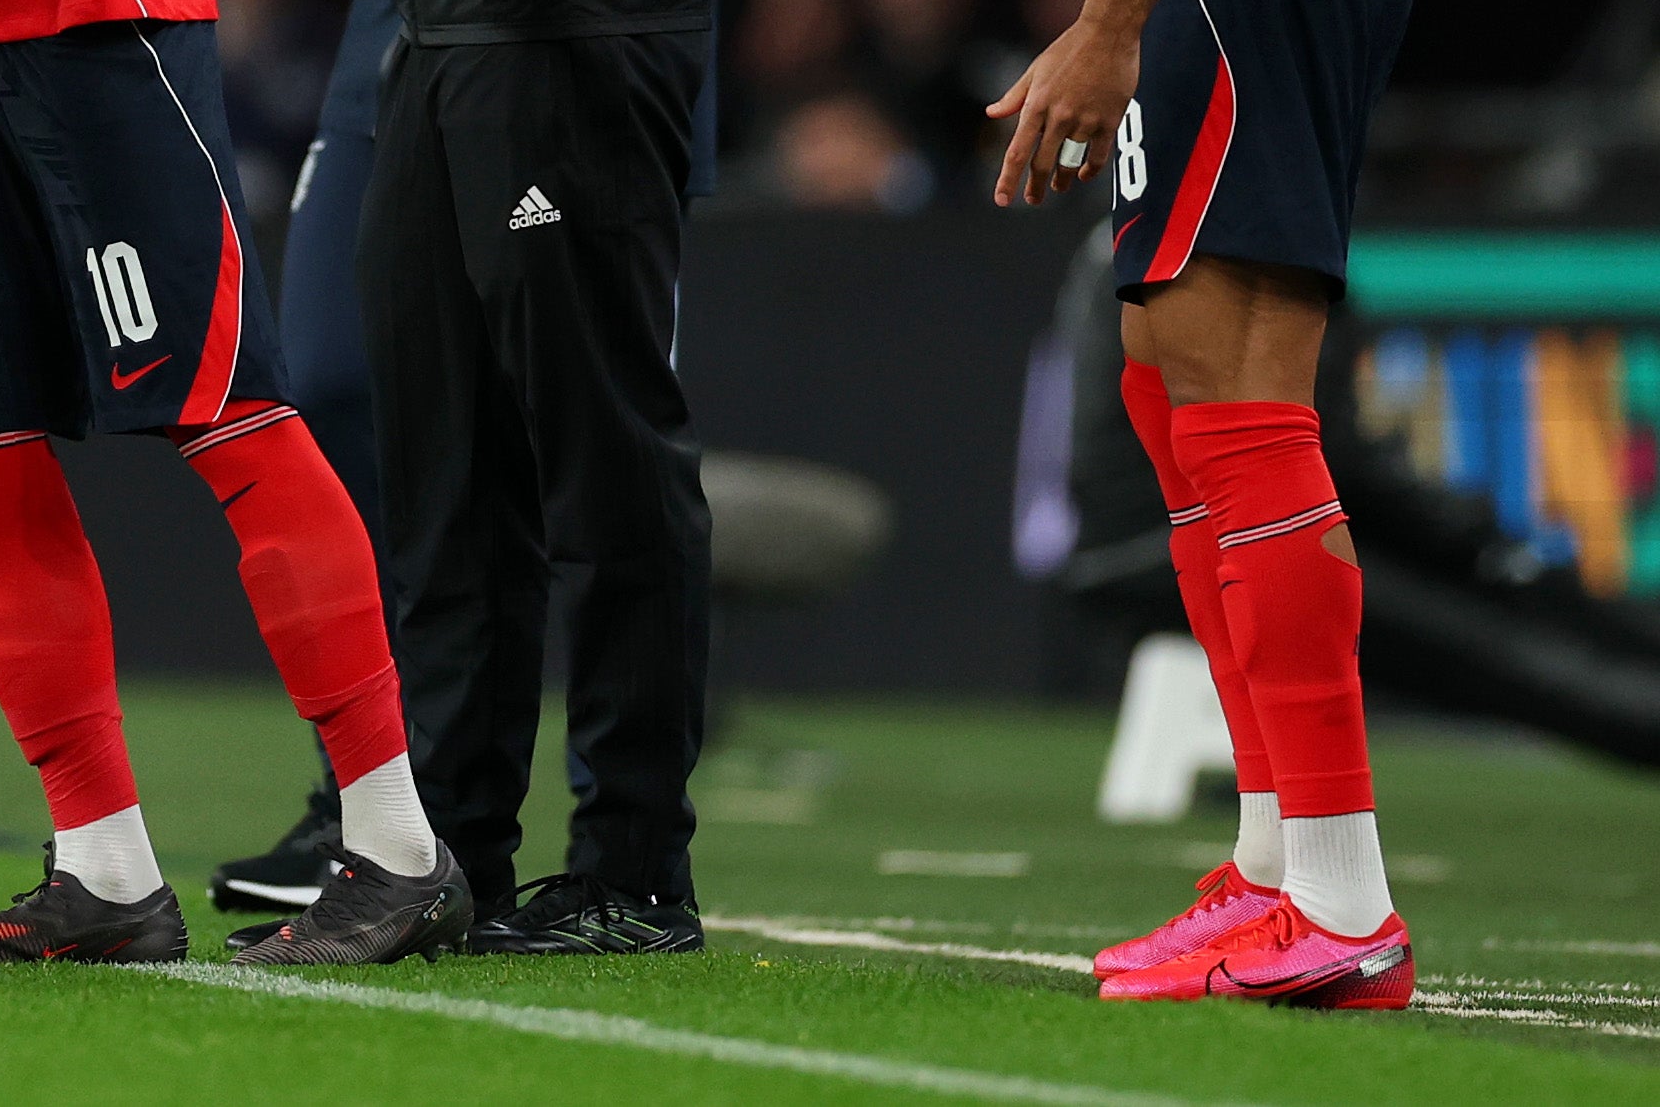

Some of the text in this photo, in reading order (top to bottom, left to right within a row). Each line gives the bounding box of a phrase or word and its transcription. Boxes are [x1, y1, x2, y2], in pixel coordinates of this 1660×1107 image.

[1111, 97, 1148, 211] 8
[508, 209, 562, 231] adidas
[86, 241, 159, 347] 10
